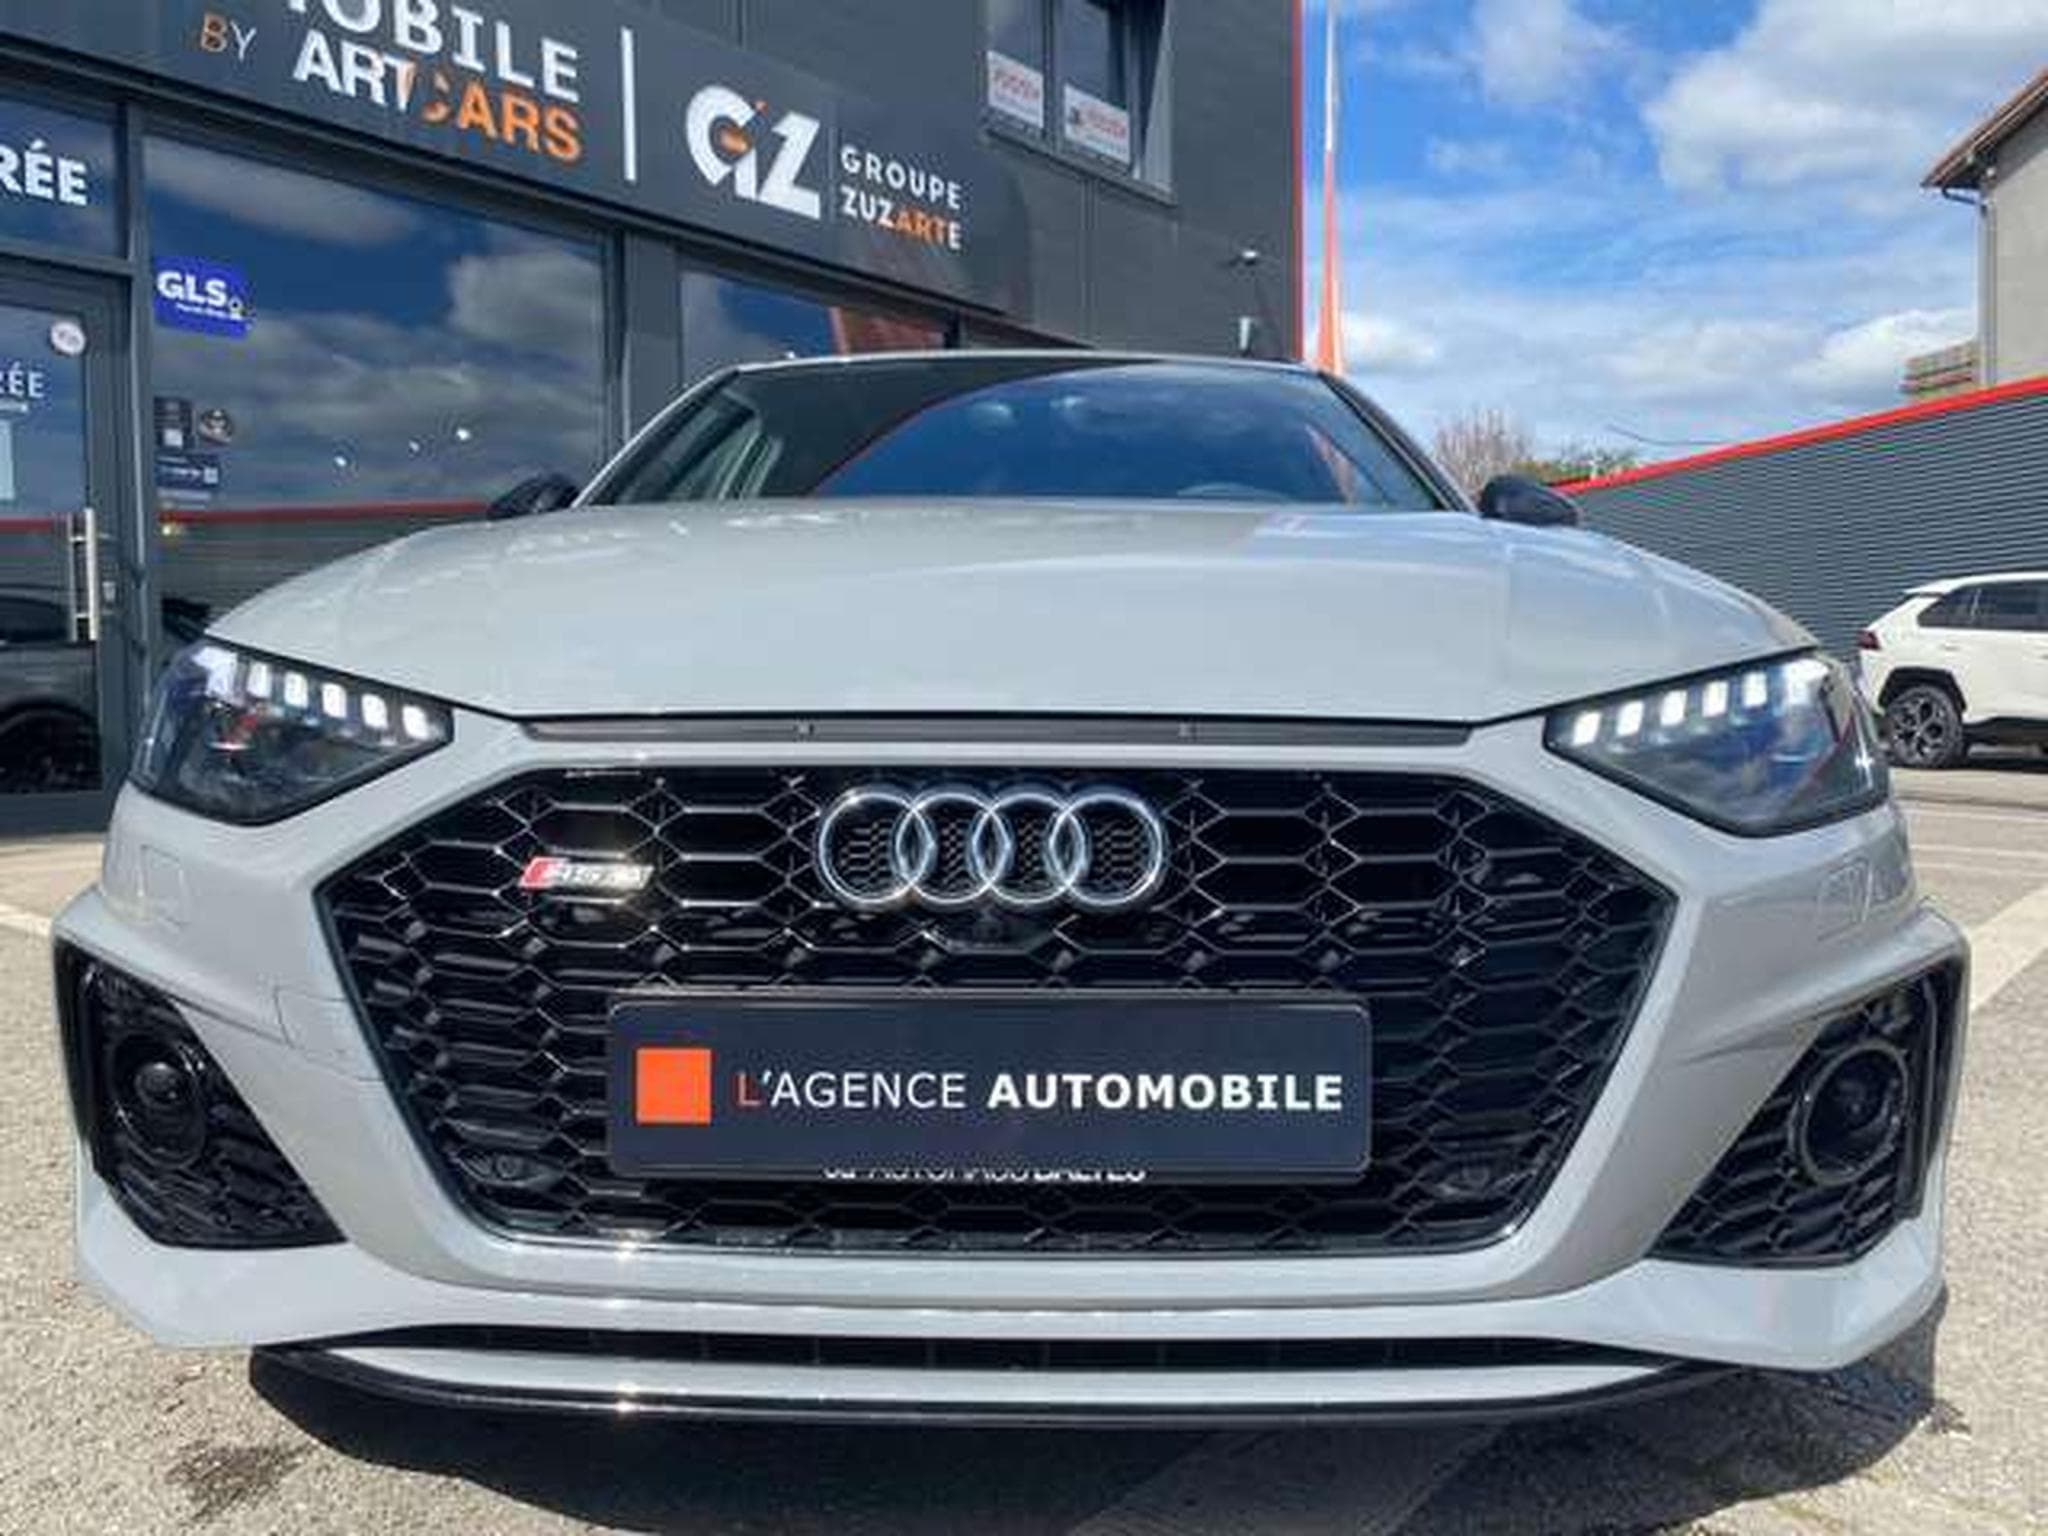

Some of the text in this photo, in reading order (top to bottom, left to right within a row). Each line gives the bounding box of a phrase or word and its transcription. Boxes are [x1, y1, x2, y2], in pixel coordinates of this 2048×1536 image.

[200, 14, 256, 62] BY
[840, 145, 962, 209] GROUPE
[840, 186, 962, 249] ZUZARTE
[157, 270, 227, 307] GLS
[0, 361, 44, 398] ÉE
[738, 1070, 1343, 1110] L'AGENCE AUTOMOBILE
